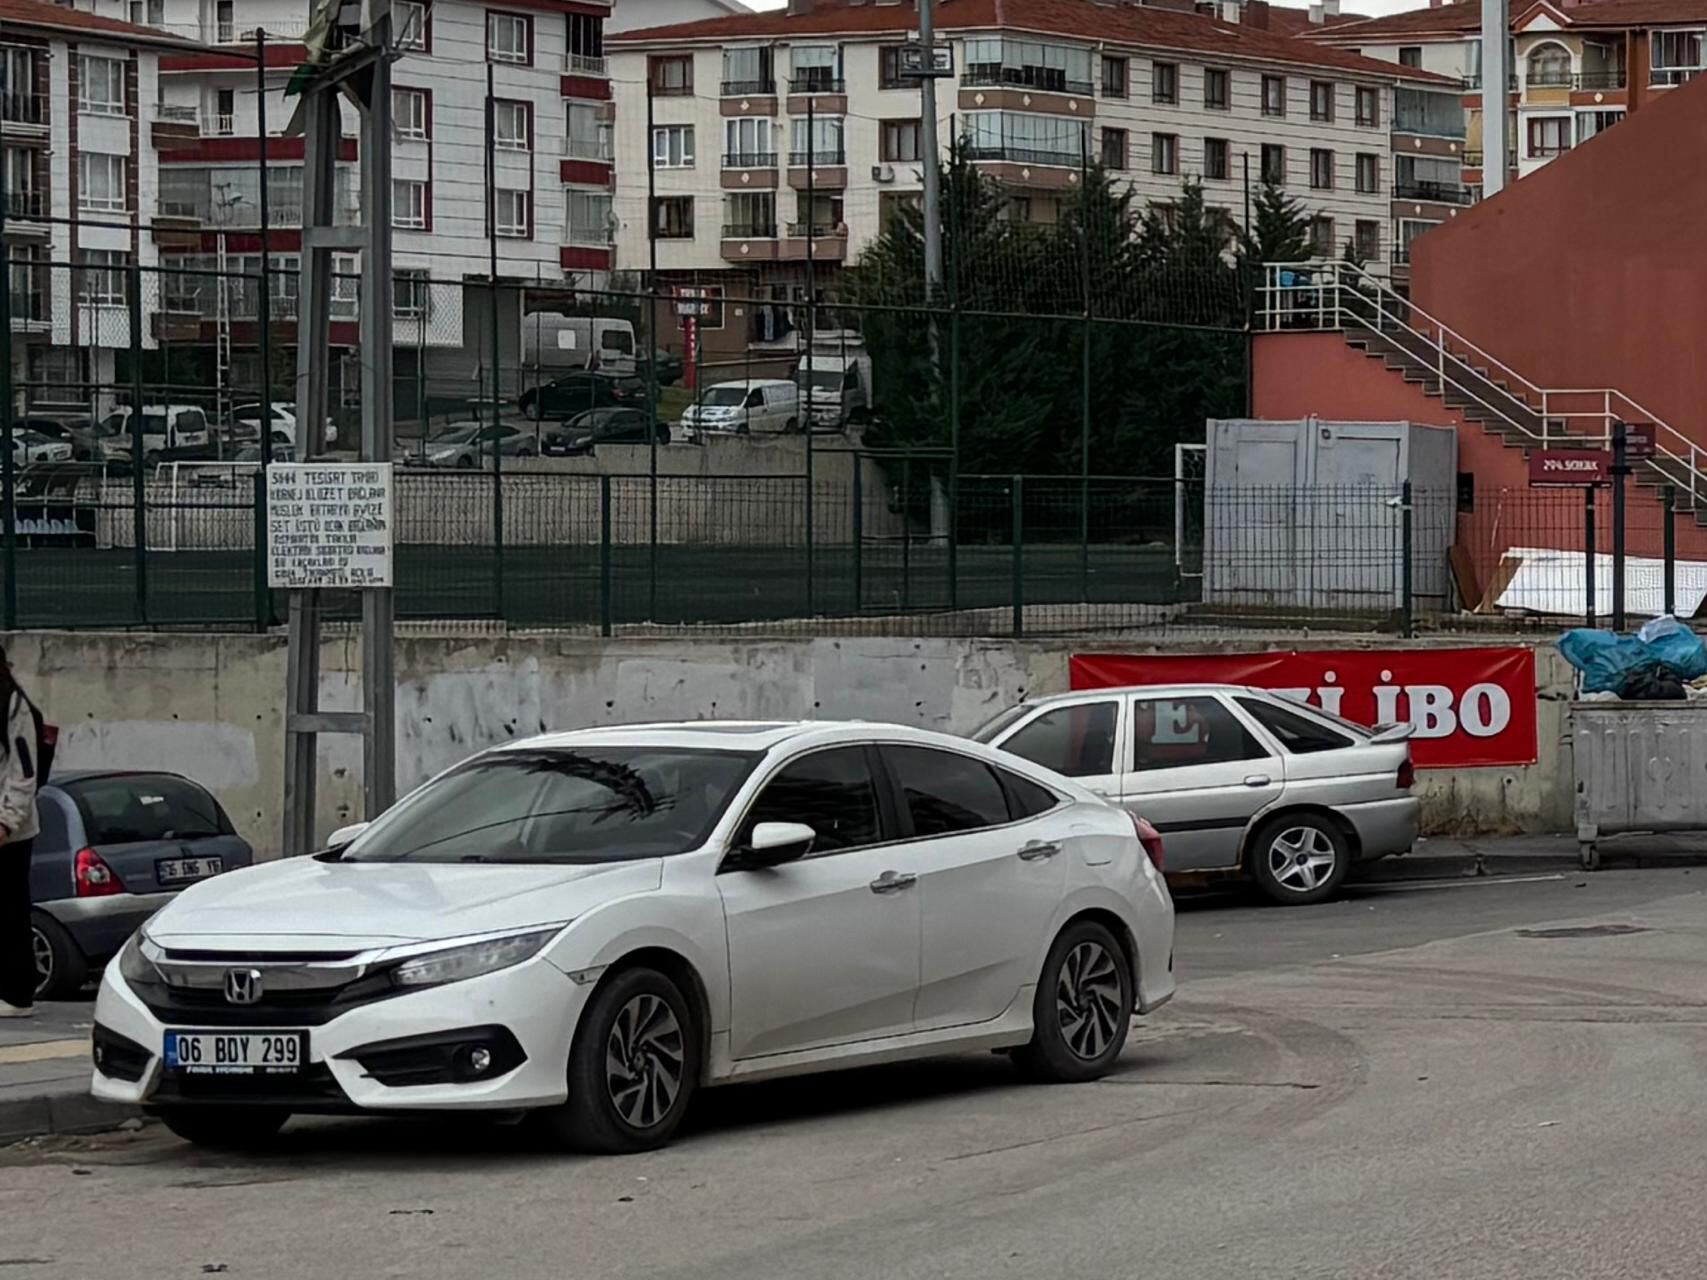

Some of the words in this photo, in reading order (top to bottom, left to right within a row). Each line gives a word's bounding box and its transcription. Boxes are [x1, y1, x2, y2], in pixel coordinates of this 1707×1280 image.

[1372, 669, 1512, 738] İBO
[178, 1036, 202, 1062] 06
[215, 1036, 250, 1063] BDY
[261, 1037, 297, 1062] 299
